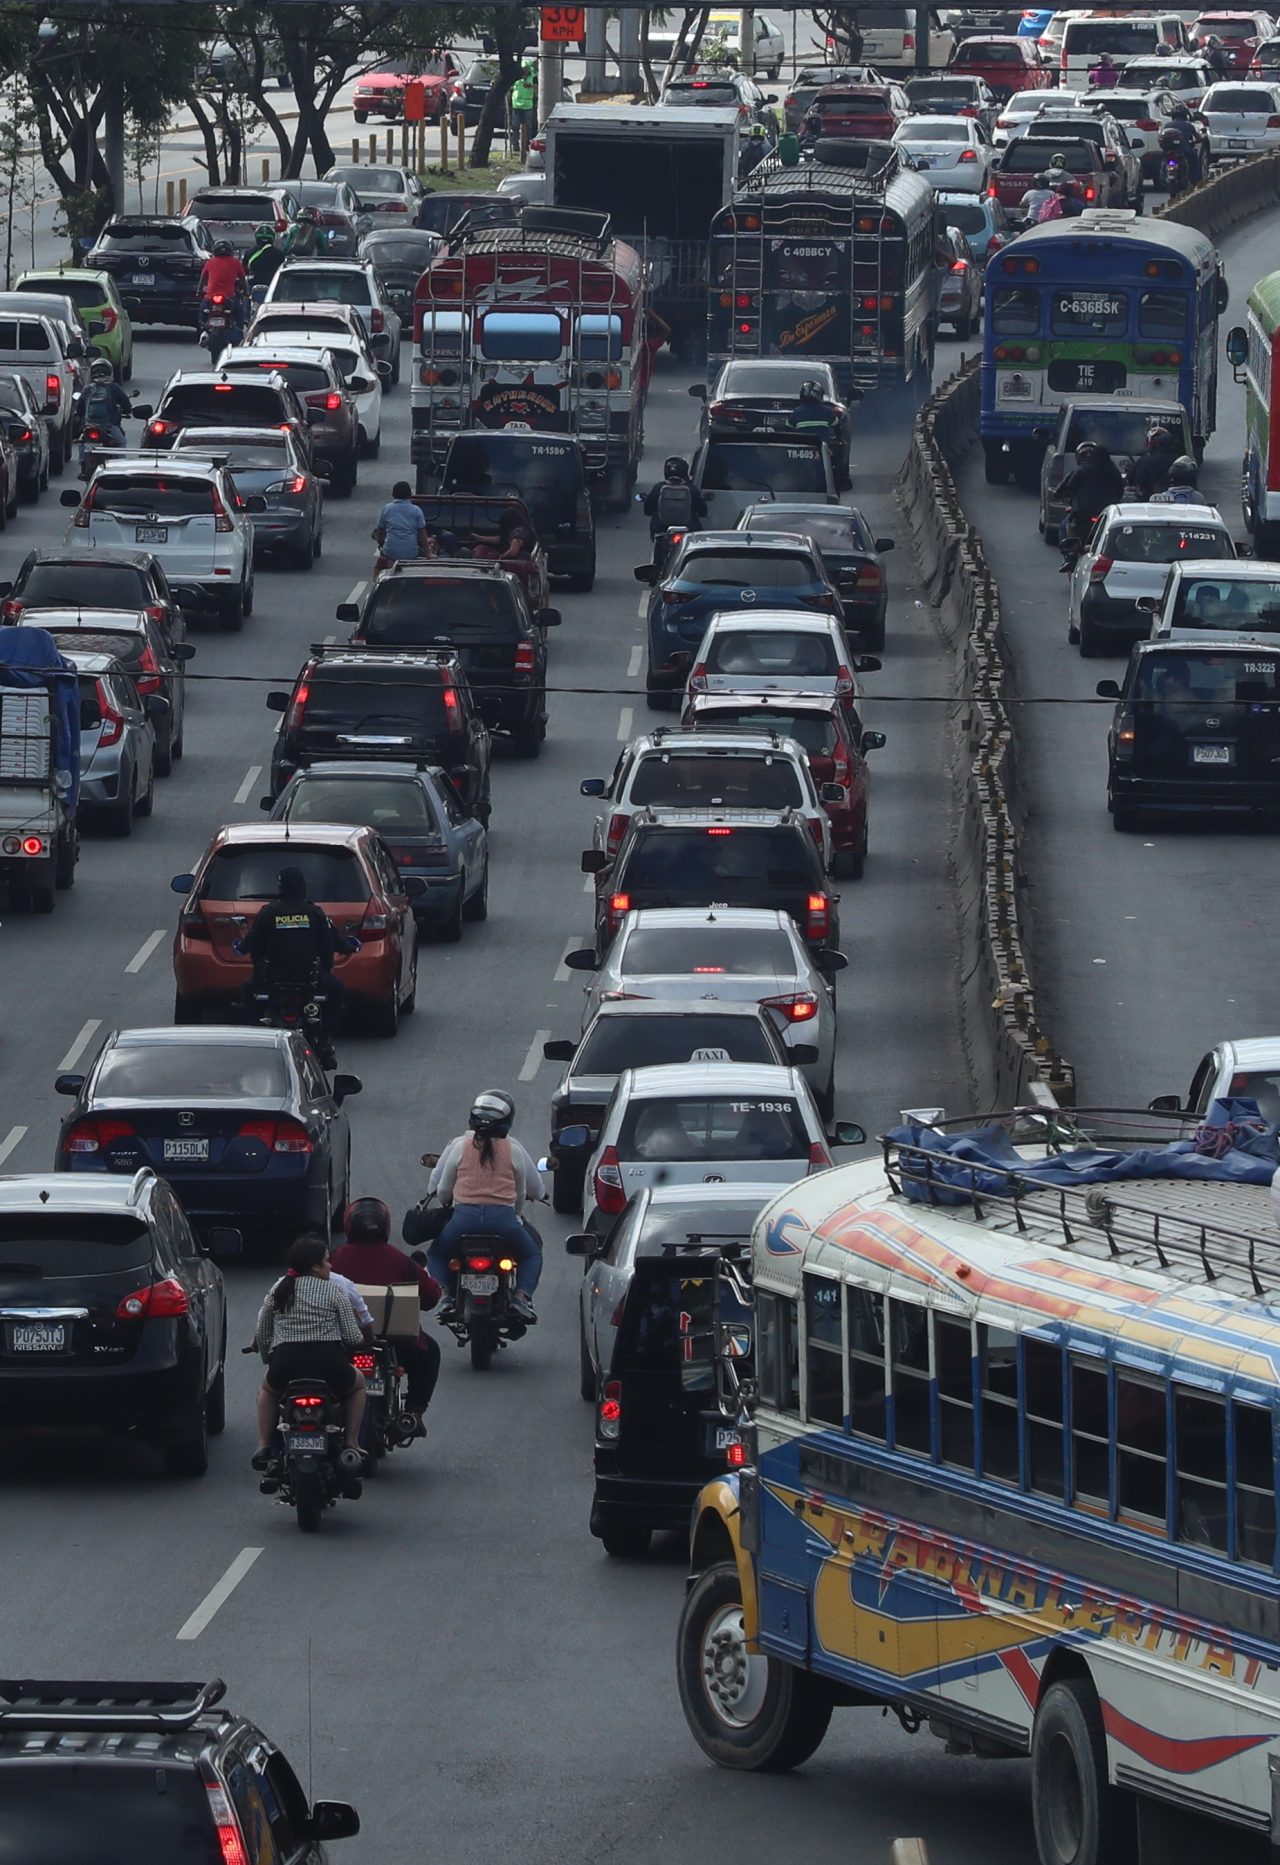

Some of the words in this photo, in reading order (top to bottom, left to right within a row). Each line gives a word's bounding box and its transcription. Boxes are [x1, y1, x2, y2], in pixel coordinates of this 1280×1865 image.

[552, 27, 575, 37] KPH
[1078, 365, 1095, 377] TIE
[1244, 662, 1276, 673] TR-3225
[275, 915, 310, 924] POLICIA
[696, 1051, 724, 1060] TAXI
[166, 1143, 208, 1156] P115DLN
[14, 1344, 57, 1352] NISSAN
